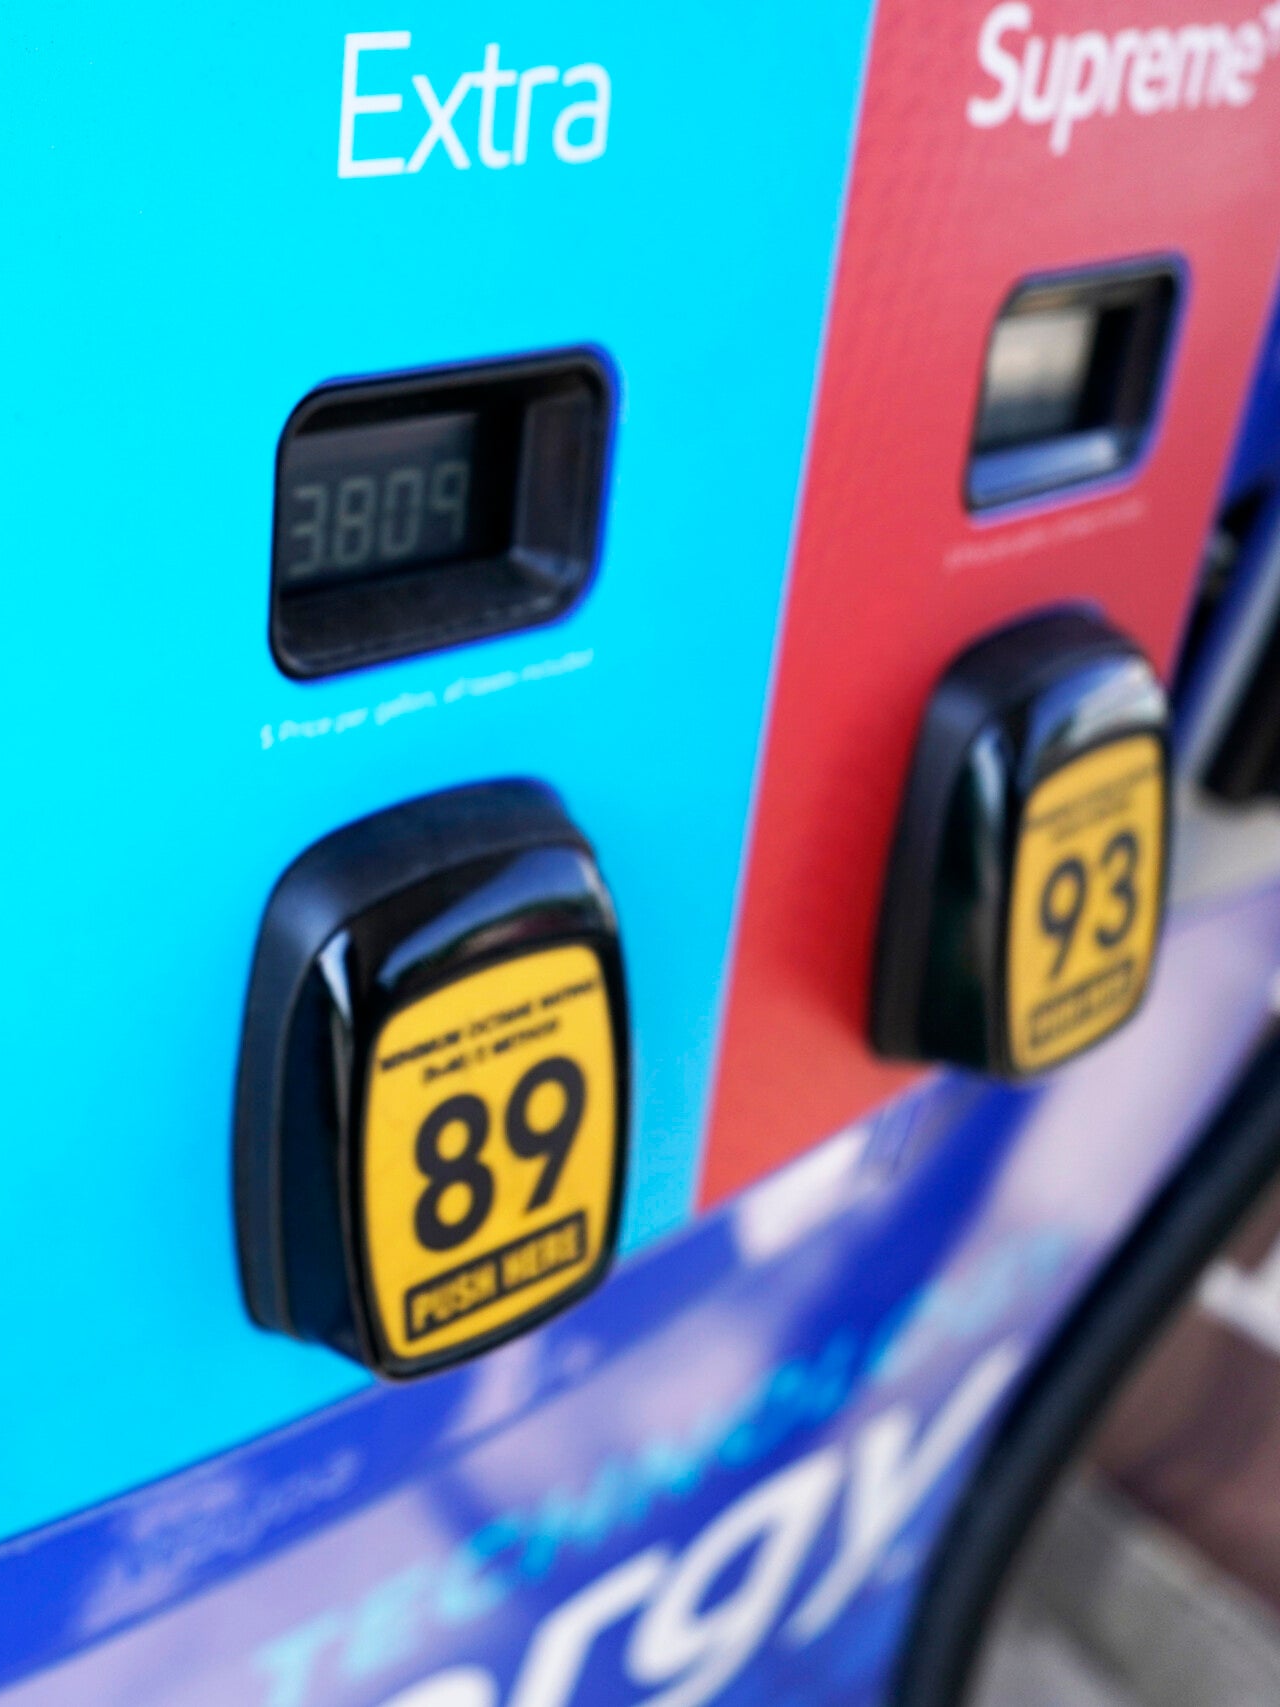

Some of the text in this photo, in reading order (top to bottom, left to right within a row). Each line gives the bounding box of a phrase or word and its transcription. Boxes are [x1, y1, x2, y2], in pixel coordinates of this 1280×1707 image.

[337, 31, 611, 178] Extra
[1039, 830, 1143, 980] 93
[414, 1056, 587, 1252] 89
[412, 1221, 578, 1331] PUSH HERE
